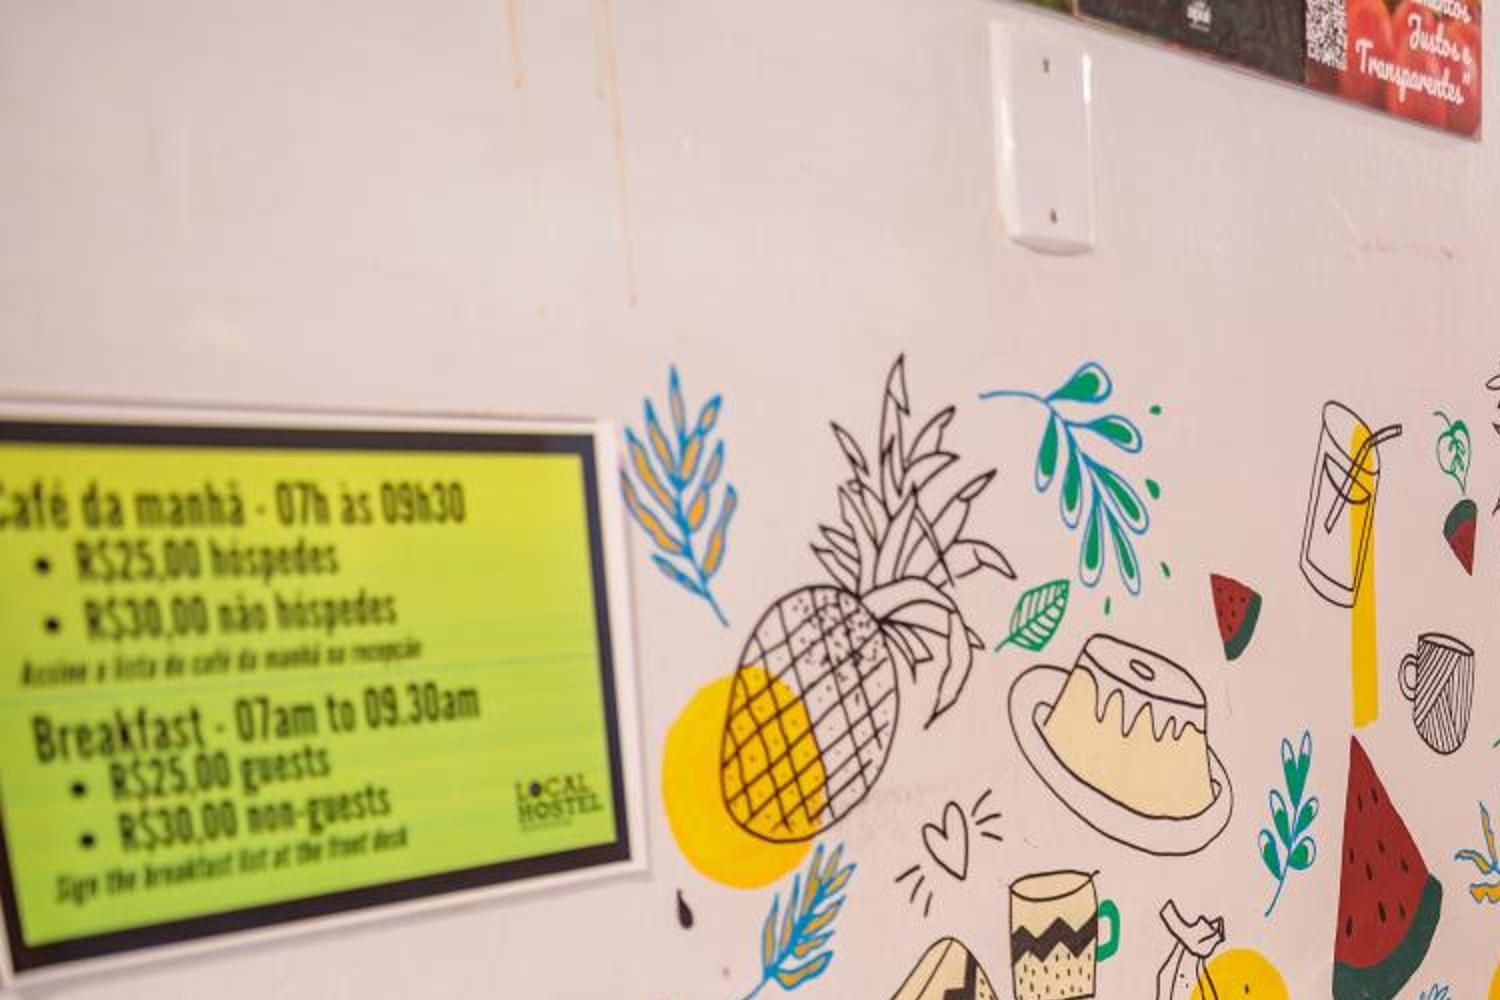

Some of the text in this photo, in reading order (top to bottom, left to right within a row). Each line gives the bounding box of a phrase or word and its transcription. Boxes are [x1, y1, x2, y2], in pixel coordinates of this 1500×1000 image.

[1407, 13, 1460, 62] Justos
[80, 480, 125, 530] da
[275, 480, 330, 527] 07h
[380, 480, 467, 525] 09h30
[75, 538, 202, 585] R$25,00
[84, 594, 209, 642] R$30,00
[31, 706, 206, 766] Breakfast
[234, 695, 319, 743] 07am
[325, 692, 356, 734] to
[363, 680, 480, 729] 09.30am
[240, 744, 331, 798] guests
[247, 784, 391, 837] non-guests
[517, 793, 604, 823] HOSTEL
